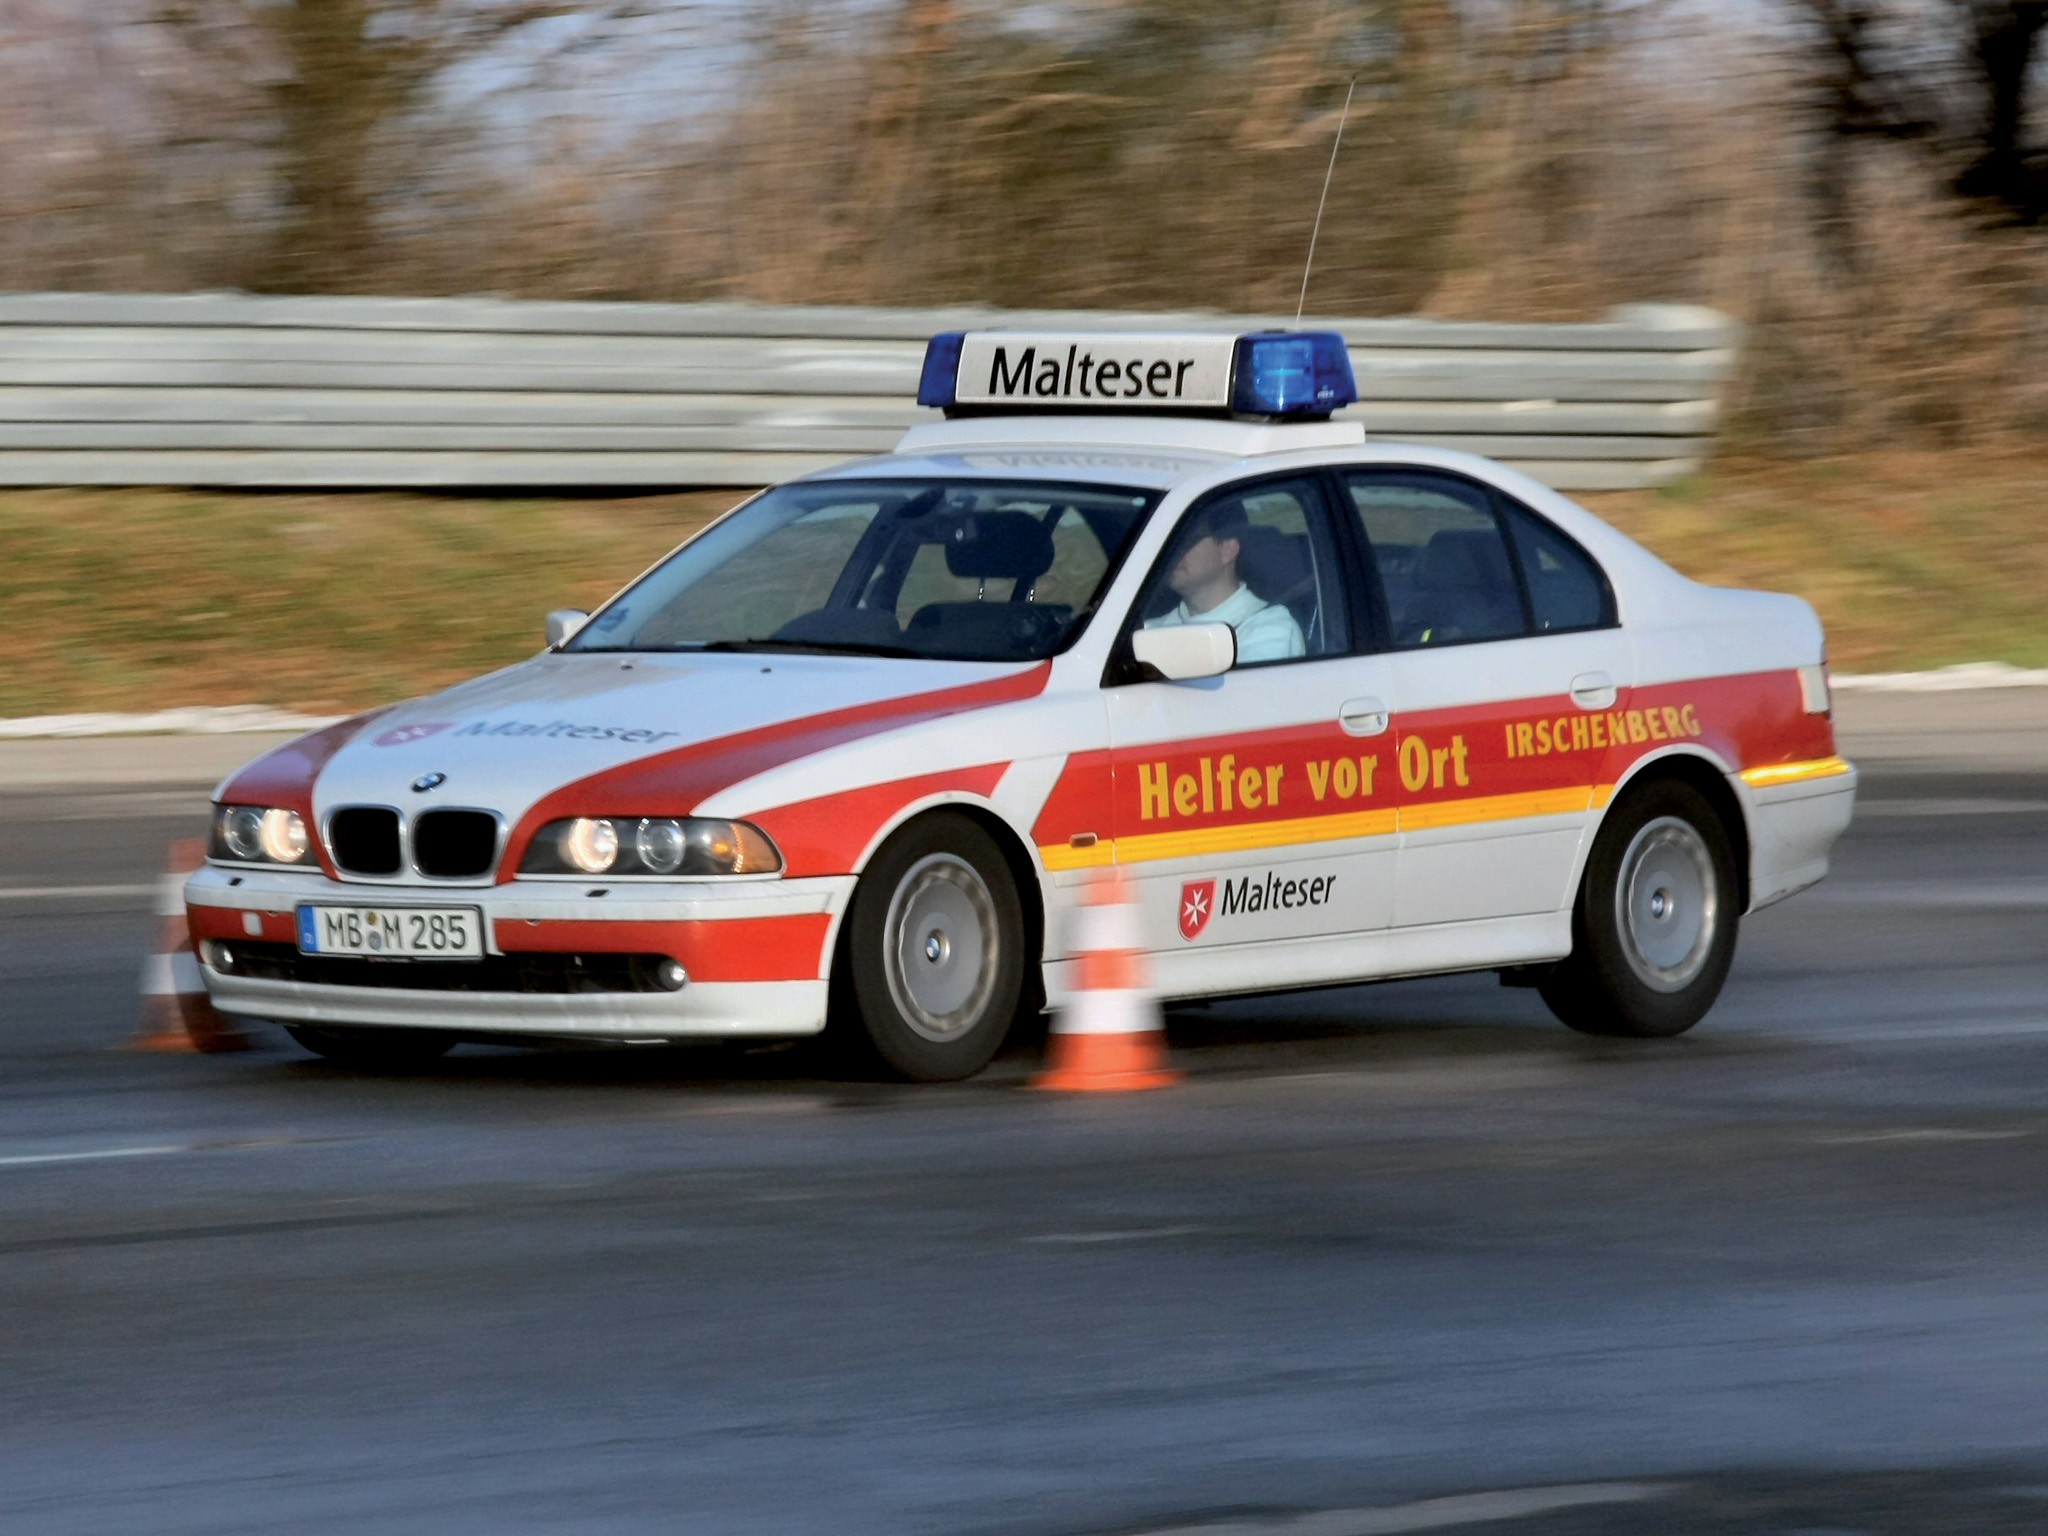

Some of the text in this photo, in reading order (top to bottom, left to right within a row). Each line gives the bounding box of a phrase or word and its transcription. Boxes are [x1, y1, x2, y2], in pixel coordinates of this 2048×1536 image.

[989, 344, 1194, 398] Malteser
[455, 720, 678, 743] Malteser
[1505, 704, 1701, 758] IRSCHENBERG
[1138, 735, 1469, 820] Helfer vor Ort
[1222, 871, 1336, 916] Malteser
[325, 912, 466, 949] MB M 285
